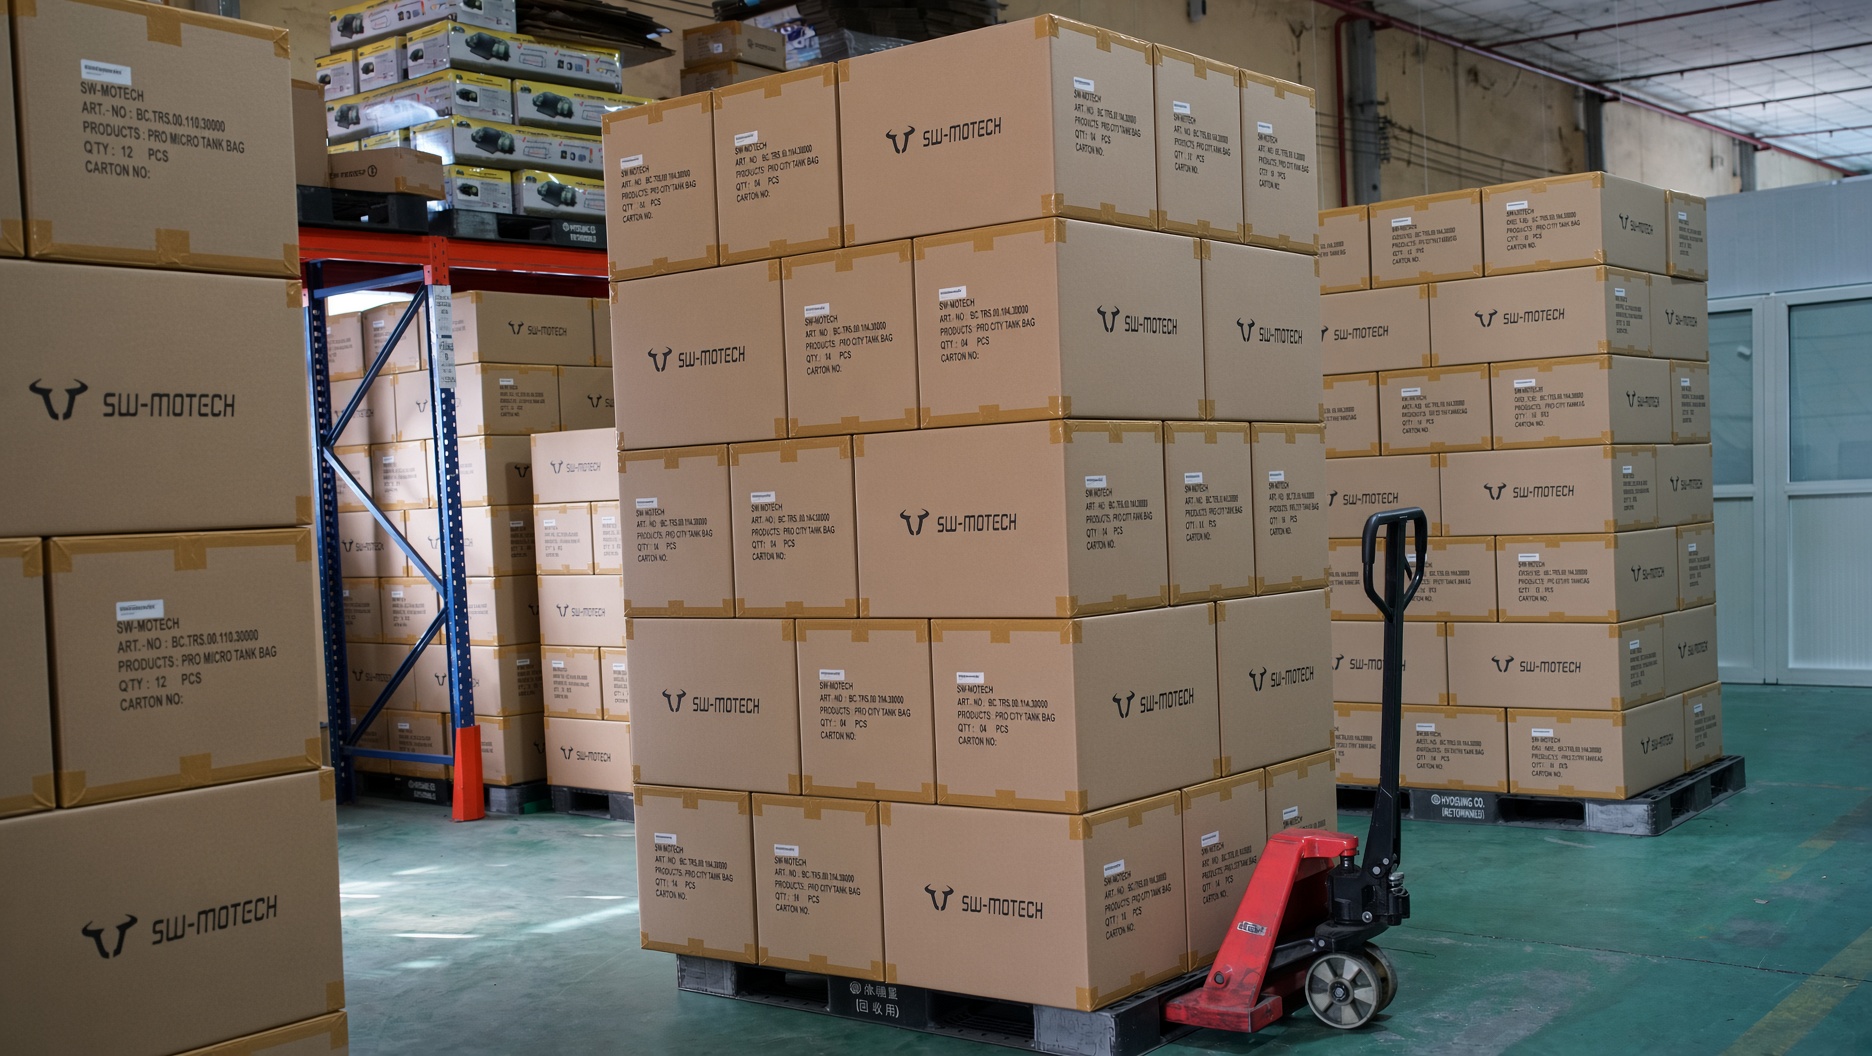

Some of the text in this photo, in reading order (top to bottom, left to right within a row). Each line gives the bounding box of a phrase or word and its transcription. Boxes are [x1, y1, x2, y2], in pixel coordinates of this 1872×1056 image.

[80, 82, 144, 102] SW-MOTECH
[137, 108, 225, 132] BC.TRS.00.110.30000
[923, 117, 1001, 147] SW-MOTECH
[148, 129, 167, 143] PRO
[170, 132, 199, 147] MICRO
[201, 137, 223, 150] TANK
[226, 140, 244, 153] BAG
[121, 146, 133, 158] 12
[149, 148, 169, 162] PCS
[807, 156, 818, 165] BAG
[86, 161, 150, 179] CARTON NO:
[768, 176, 779, 185] PCS
[1503, 308, 1565, 325] SW-MOTECH
[528, 326, 567, 336] SW-MOTECH
[990, 321, 1004, 331] CITY
[1005, 319, 1021, 329] TANK
[1022, 318, 1035, 327] BAG
[1125, 316, 1177, 334] SW-MOTECH
[880, 334, 893, 342] BAG
[1259, 327, 1302, 344] SW-MOTECH
[1334, 326, 1388, 341] SW-MOTECH
[977, 337, 990, 346] PCS
[679, 346, 745, 368] SW-MOTECH
[839, 351, 851, 360] PCS
[941, 352, 966, 362] CARTON
[806, 365, 830, 375] CARTON
[104, 392, 234, 417] SW-MOTECH
[566, 462, 601, 472] SW-MOTECH
[1513, 485, 1574, 498] SW-MOTECH
[1343, 492, 1398, 505] SW-MOTECH
[937, 513, 1016, 532] SW-MOTECH
[702, 529, 712, 537] BAG
[823, 526, 835, 534] BAG
[571, 607, 605, 617] SW-MOTECH
[117, 618, 179, 634] SW-MOTECH
[172, 630, 258, 648] BC.TRS.00.110.30000
[182, 653, 200, 666] PRO
[204, 650, 231, 664] MICRO
[234, 648, 257, 661] TANK
[259, 645, 277, 658] BAG
[1349, 658, 1406, 672] SW-MOH
[1520, 661, 1581, 673] SW-MOTECH
[155, 676, 166, 688] 12
[182, 672, 201, 685] PCS
[1271, 666, 1314, 687] SW-MOTECH
[120, 693, 183, 711] CARTON NO:
[693, 697, 759, 714] SW-MOTECH
[1140, 688, 1194, 713] SW-MOTECH
[854, 707, 866, 716] PRO
[868, 708, 880, 716] CITY
[882, 708, 897, 716] TANK
[898, 709, 911, 717] BAG
[995, 711, 1008, 720] PRO
[1009, 712, 1023, 721] CITY
[1025, 713, 1040, 721] TANK
[1042, 713, 1055, 722] BAG
[854, 720, 867, 728] PCS
[995, 725, 1009, 733] PCS
[820, 731, 844, 739] CARTON
[958, 736, 984, 745] CARTON
[576, 751, 611, 762] SW-MOTECH
[722, 874, 733, 882] BAG
[685, 882, 696, 890] PCS
[820, 884, 832, 893] CITY
[848, 887, 860, 895] BAG
[808, 895, 819, 904] PCS
[962, 896, 1043, 919] SW-MOTECH
[152, 895, 277, 945] SW-MOTECH
